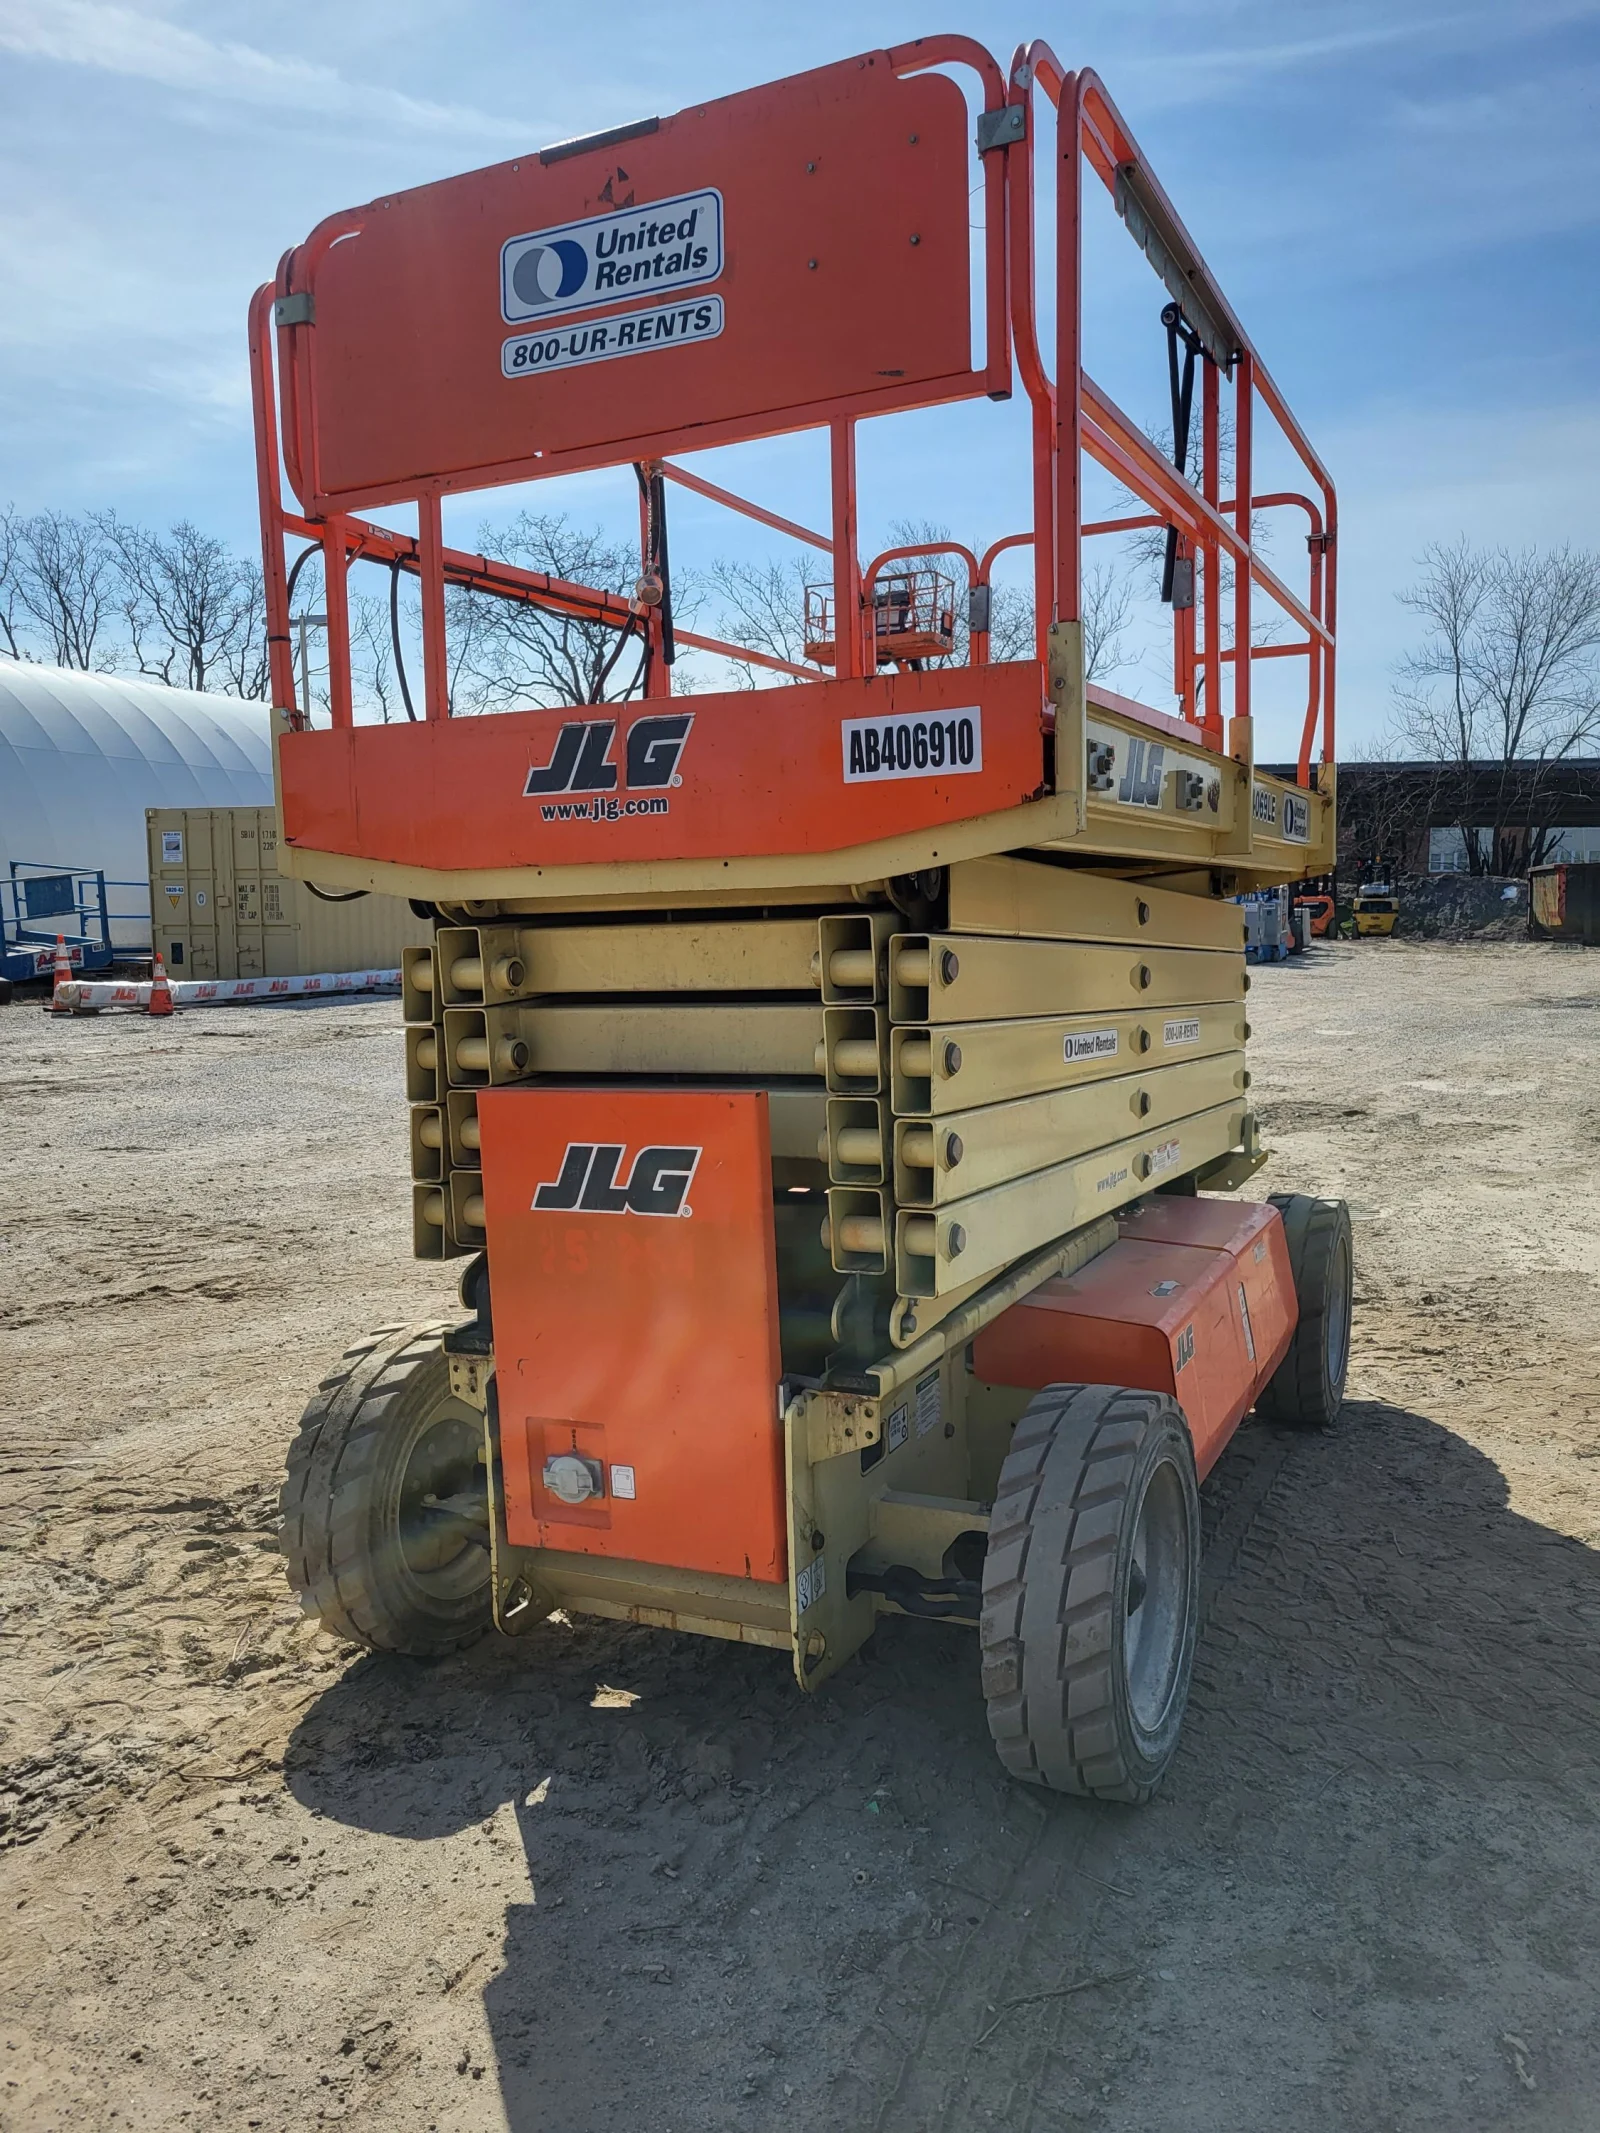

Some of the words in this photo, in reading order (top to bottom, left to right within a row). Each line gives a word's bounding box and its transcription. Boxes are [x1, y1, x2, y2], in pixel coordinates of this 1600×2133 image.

[595, 208, 699, 259] United
[594, 242, 709, 291] Rentals
[512, 304, 713, 368] 800-UR-RENTS
[522, 712, 697, 797] JLG
[849, 717, 975, 775] AB406910
[1117, 736, 1165, 809] JLG
[540, 796, 669, 823] www.jlg.com
[111, 988, 137, 1001] JLG
[233, 983, 256, 995] JLG
[1074, 1036, 1095, 1056] United
[1095, 1033, 1116, 1052] Rentals
[530, 1142, 703, 1218] JLG
[1176, 1321, 1196, 1376] JLG
